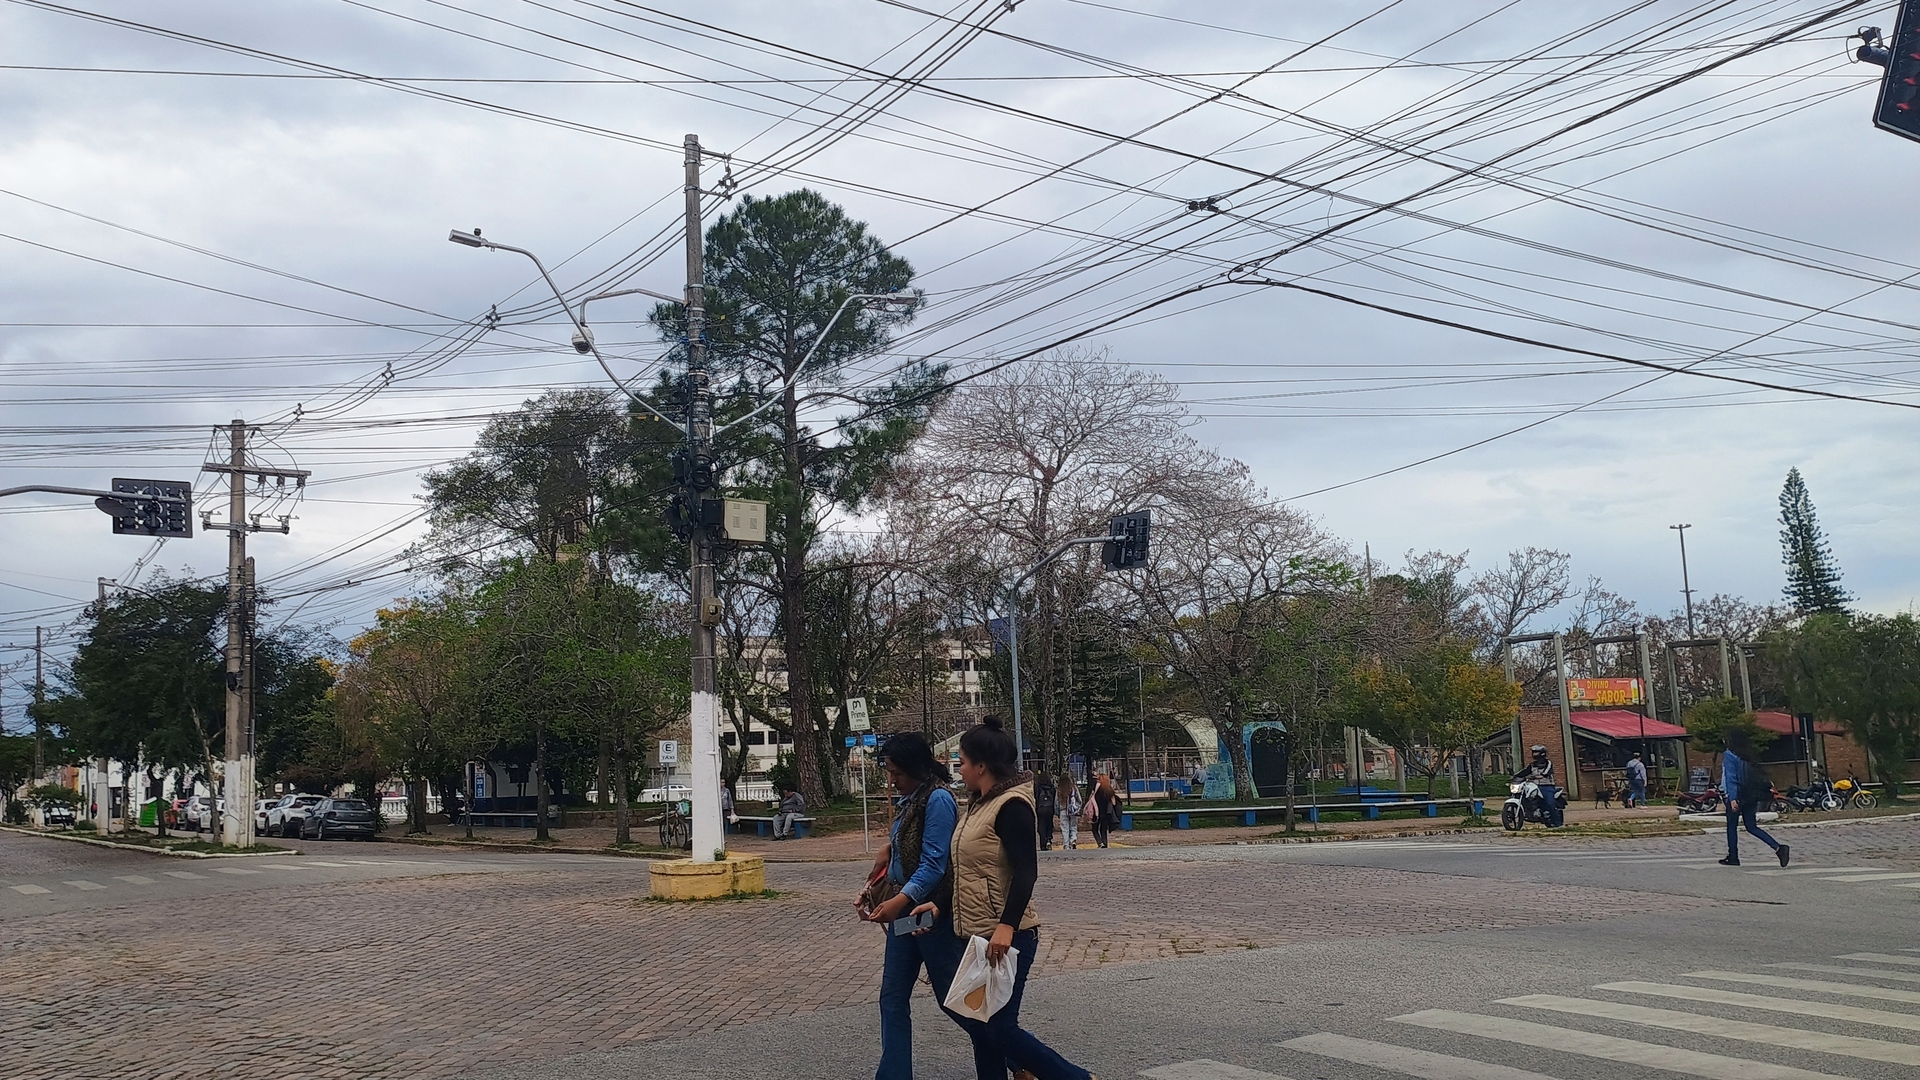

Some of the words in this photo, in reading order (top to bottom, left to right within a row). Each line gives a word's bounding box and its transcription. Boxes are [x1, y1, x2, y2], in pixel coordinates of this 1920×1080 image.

[1586, 680, 1609, 689] DIVINO
[1596, 689, 1626, 704] SABOR
[850, 710, 866, 719] Prime
[665, 743, 672, 752] E
